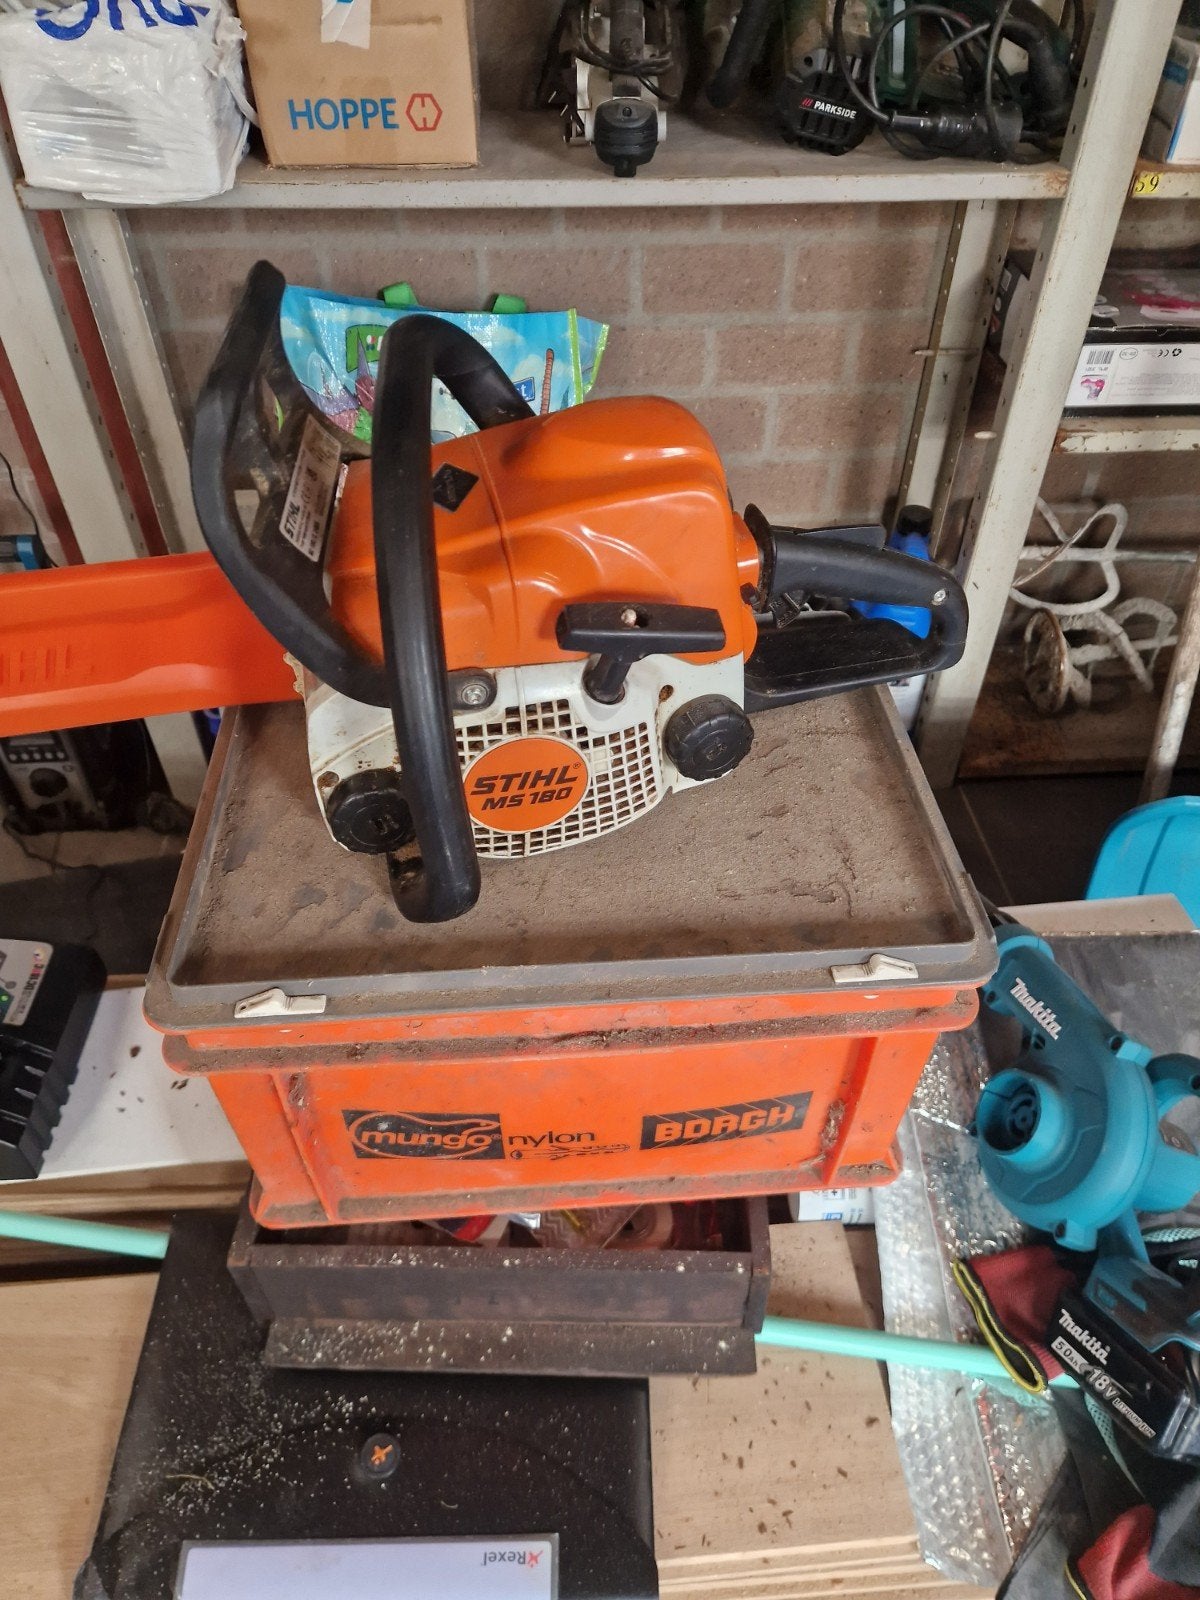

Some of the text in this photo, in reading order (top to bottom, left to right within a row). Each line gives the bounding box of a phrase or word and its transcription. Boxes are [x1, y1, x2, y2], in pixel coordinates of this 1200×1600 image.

[288, 98, 399, 130] HOPPE
[813, 100, 857, 119] PARKSIDE
[283, 501, 300, 539] STIHL
[470, 765, 578, 796] STIHL
[481, 786, 573, 811] MS 180
[361, 1129, 595, 1150] mungo nylon
[483, 1550, 527, 1566] Rexel
